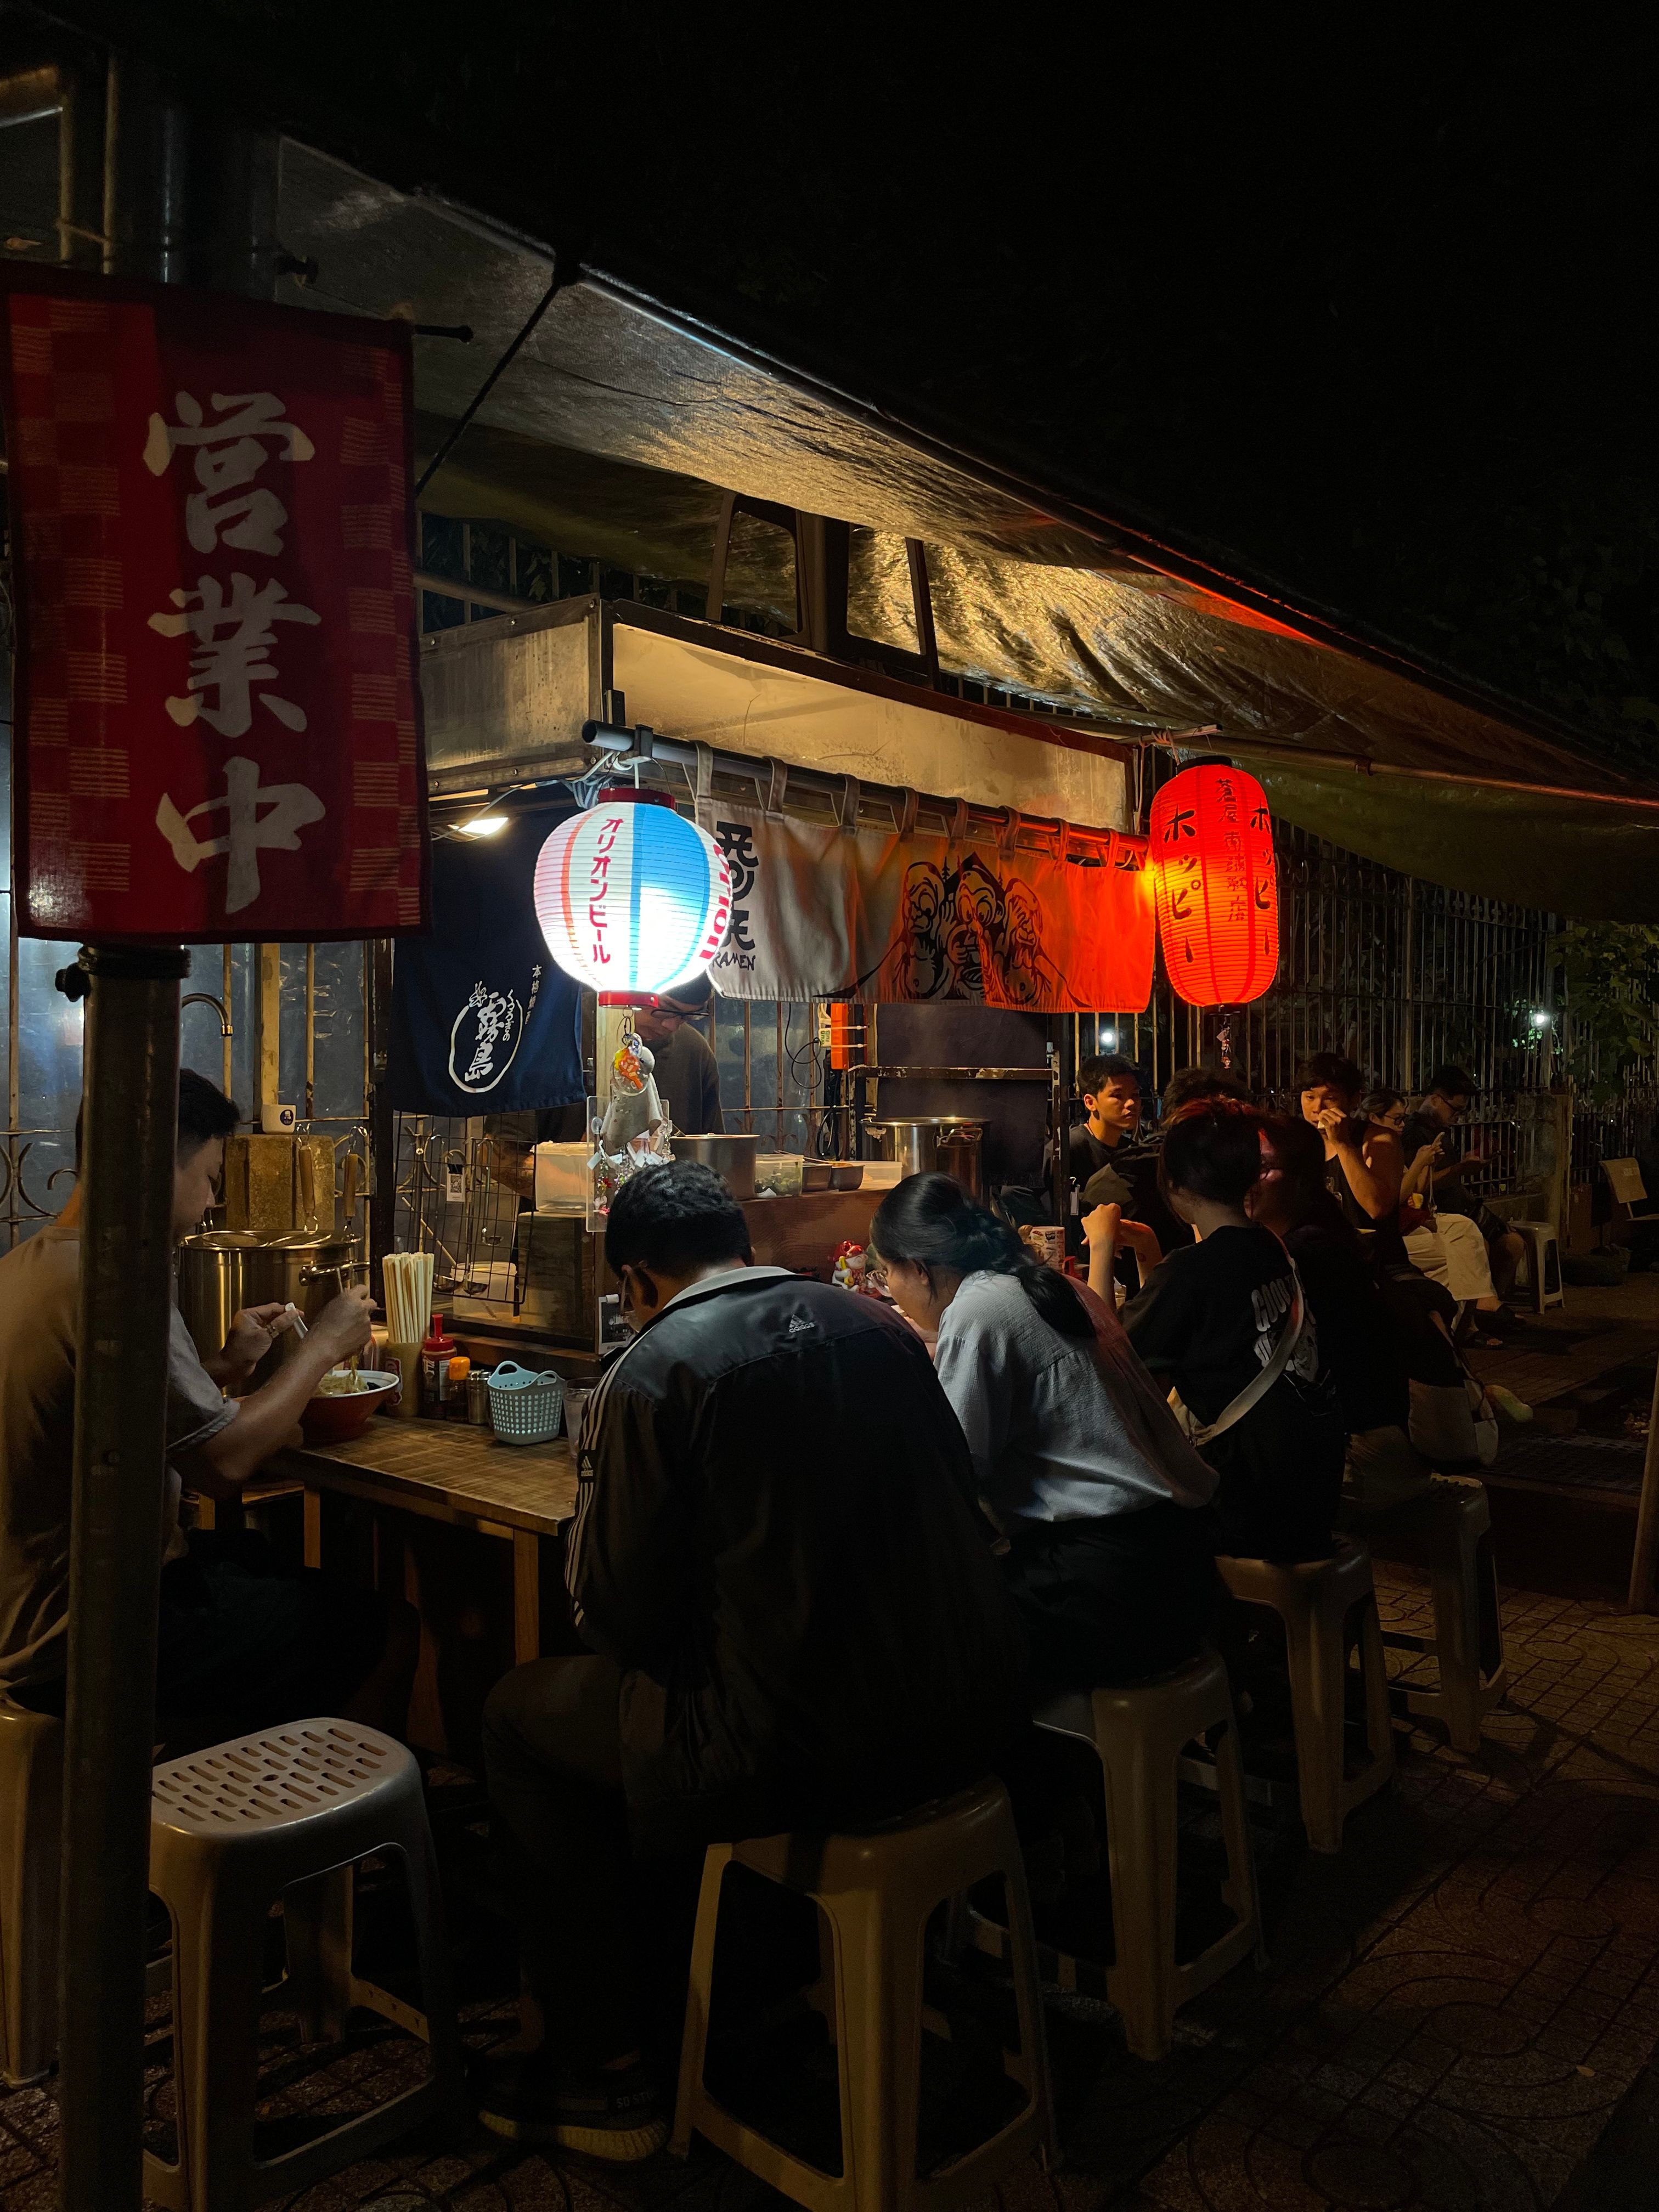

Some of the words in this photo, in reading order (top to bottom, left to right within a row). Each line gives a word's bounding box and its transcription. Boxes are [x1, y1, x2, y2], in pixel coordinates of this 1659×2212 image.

[143, 391, 325, 914] 営業中
[589, 819, 624, 964] オリオンビール
[1164, 804, 1201, 963] ホッピー
[713, 952, 756, 971] RAMEN
[789, 1322, 815, 1333] adidas
